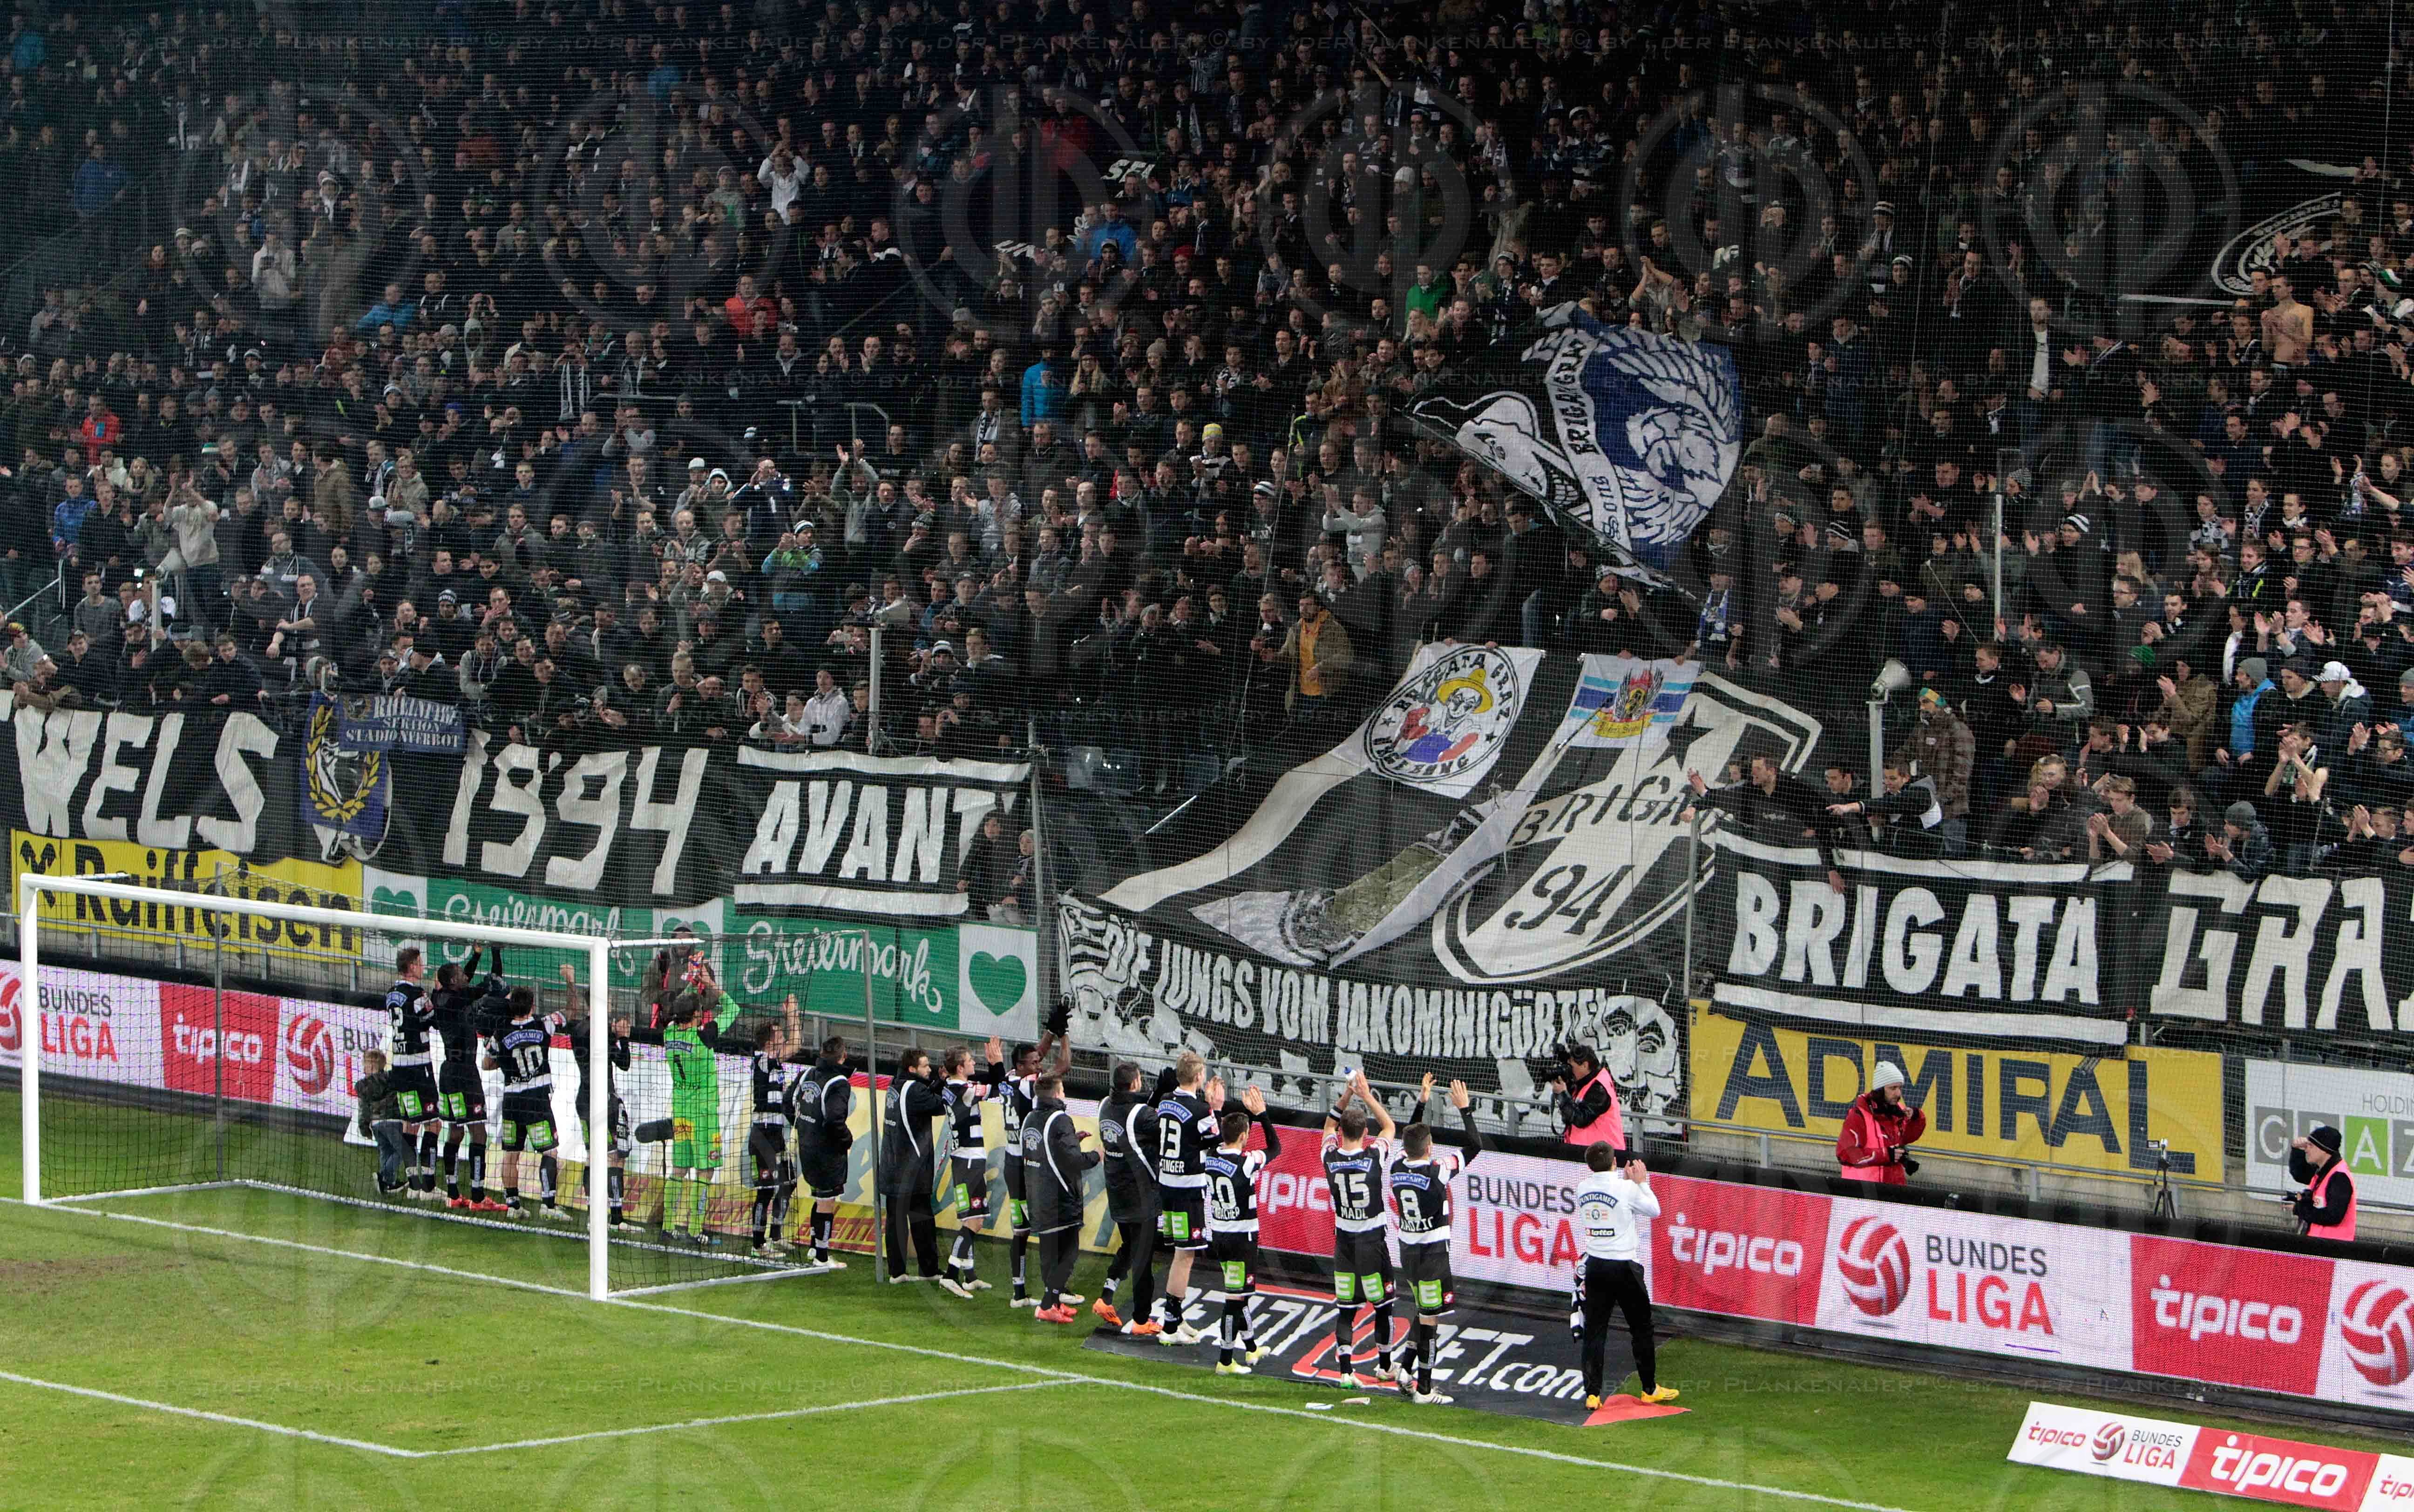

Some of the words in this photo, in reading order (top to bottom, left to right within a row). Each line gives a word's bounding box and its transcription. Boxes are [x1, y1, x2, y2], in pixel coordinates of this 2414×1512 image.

[14, 709, 279, 853] WELS
[742, 780, 1001, 883] AVANT
[1506, 776, 1700, 846] BRIGA
[1505, 864, 1635, 935] 94
[743, 921, 943, 1013] Steiermark
[1728, 872, 2101, 1004] BRIGATA
[2150, 869, 2414, 1030] GRA
[39, 986, 111, 1017] BUNDES
[1153, 938, 1254, 1028] JUNGS
[1260, 966, 1329, 1043] VOM
[41, 1015, 118, 1062] LIGA
[512, 1045, 543, 1078] 10
[1716, 1021, 2196, 1174] ADMIRAL
[1159, 1117, 1181, 1159] 13
[1253, 1169, 1336, 1215] ipic
[1334, 1173, 1370, 1208] 15
[1341, 1206, 1369, 1220] MADL
[1400, 1189, 1421, 1221] 8
[1467, 1174, 1576, 1215] BUNDES
[1579, 1193, 1616, 1207] PUNTIGAMER
[1468, 1207, 1579, 1267] LIGA
[1668, 1212, 1803, 1276] tipico
[1926, 1234, 2048, 1277] BUNDES
[1927, 1269, 2054, 1335] LIGA
[2150, 1274, 2302, 1341] tipico
[2028, 1421, 2086, 1447] tipico
[2123, 1443, 2176, 1470] LIGA
[2132, 1430, 2183, 1448] BUNDES
[2210, 1435, 2348, 1498] tipico
[2380, 1474, 2414, 1500] tipi
